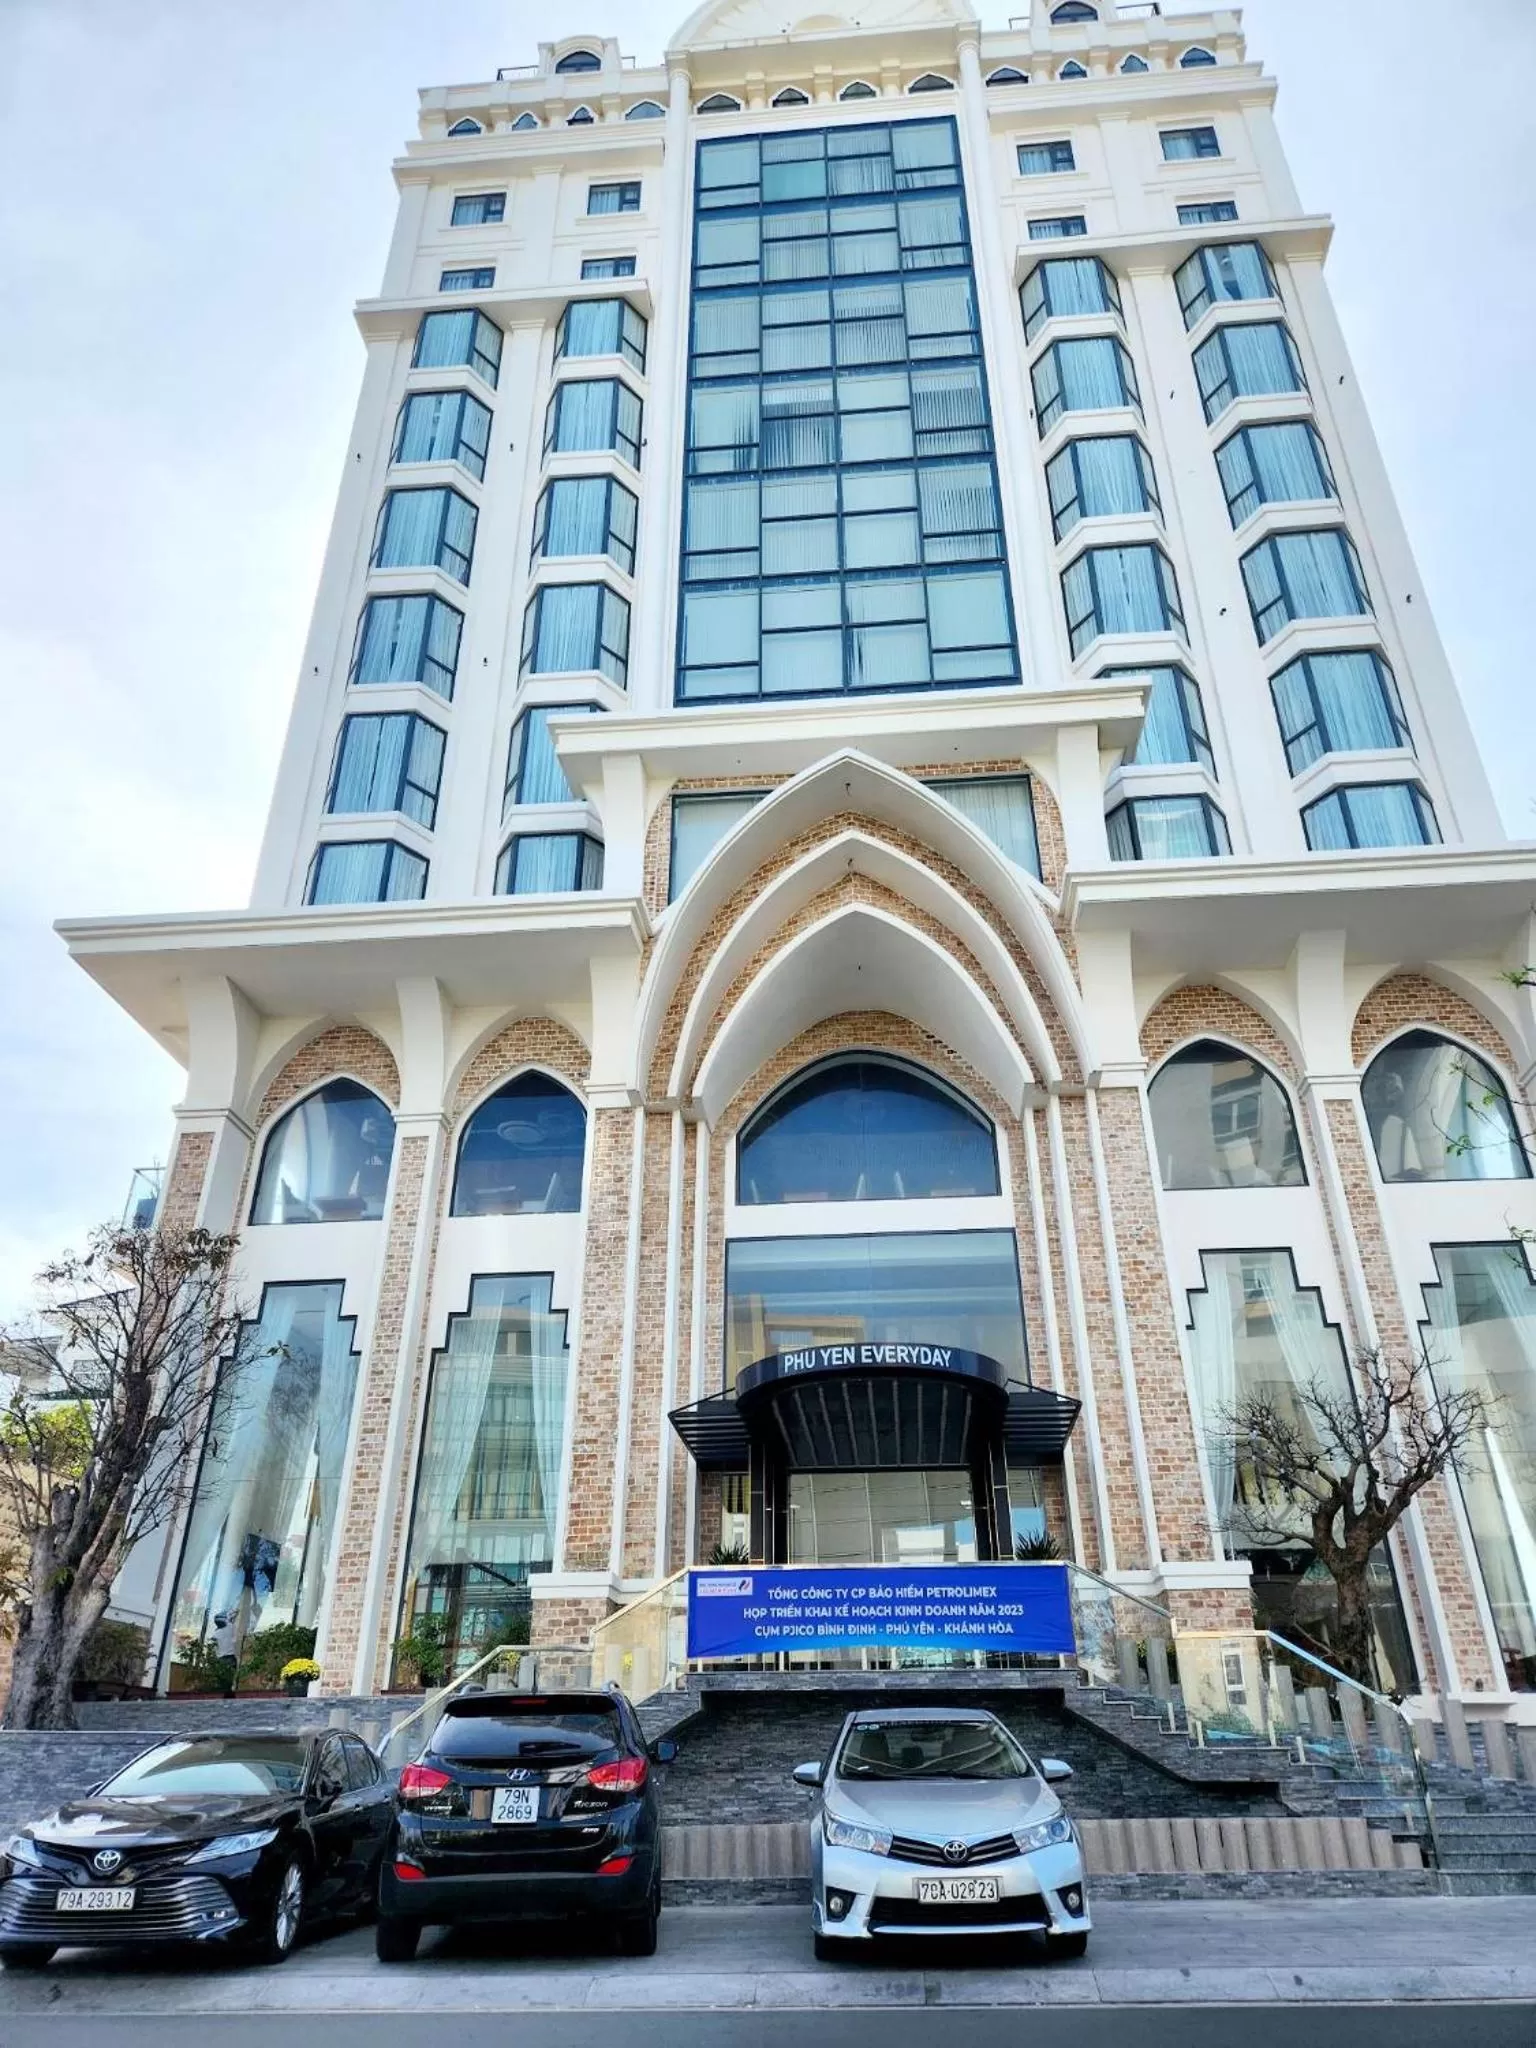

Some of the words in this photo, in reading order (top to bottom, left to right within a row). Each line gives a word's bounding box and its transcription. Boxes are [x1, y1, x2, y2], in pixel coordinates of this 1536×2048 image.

[784, 1350, 816, 1373] PHU
[822, 1347, 855, 1365] YEN
[861, 1345, 952, 1367] EVERYDAY
[768, 1586, 799, 1600] TỔNG
[801, 1586, 833, 1599] CÔNG
[836, 1588, 848, 1599] TY
[851, 1588, 866, 1599] CP
[868, 1584, 893, 1599] BẢO
[895, 1584, 924, 1598] HIỂM
[926, 1587, 997, 1598] PETROLIMEX
[743, 1607, 767, 1621] HỌP
[770, 1604, 802, 1618] TRIỂN
[805, 1606, 832, 1617] KHAI
[834, 1602, 850, 1616] KẾ
[851, 1605, 892, 1619] HOẠCH
[894, 1605, 922, 1616] KINH
[925, 1605, 966, 1616] DOANH
[969, 1602, 996, 1616] NĂM
[997, 1605, 1024, 1616] 2023
[754, 1625, 780, 1638] CỤM
[783, 1625, 814, 1636] PJICO
[817, 1622, 845, 1636] BÌNH
[847, 1624, 876, 1638] ĐỊNH
[886, 1621, 910, 1635] PHÚ
[912, 1621, 935, 1635] YÊN
[944, 1621, 985, 1634] KHÁNH
[987, 1621, 1014, 1634] HÒA
[504, 1789, 530, 1804] 79N
[498, 1805, 532, 1820] 2869
